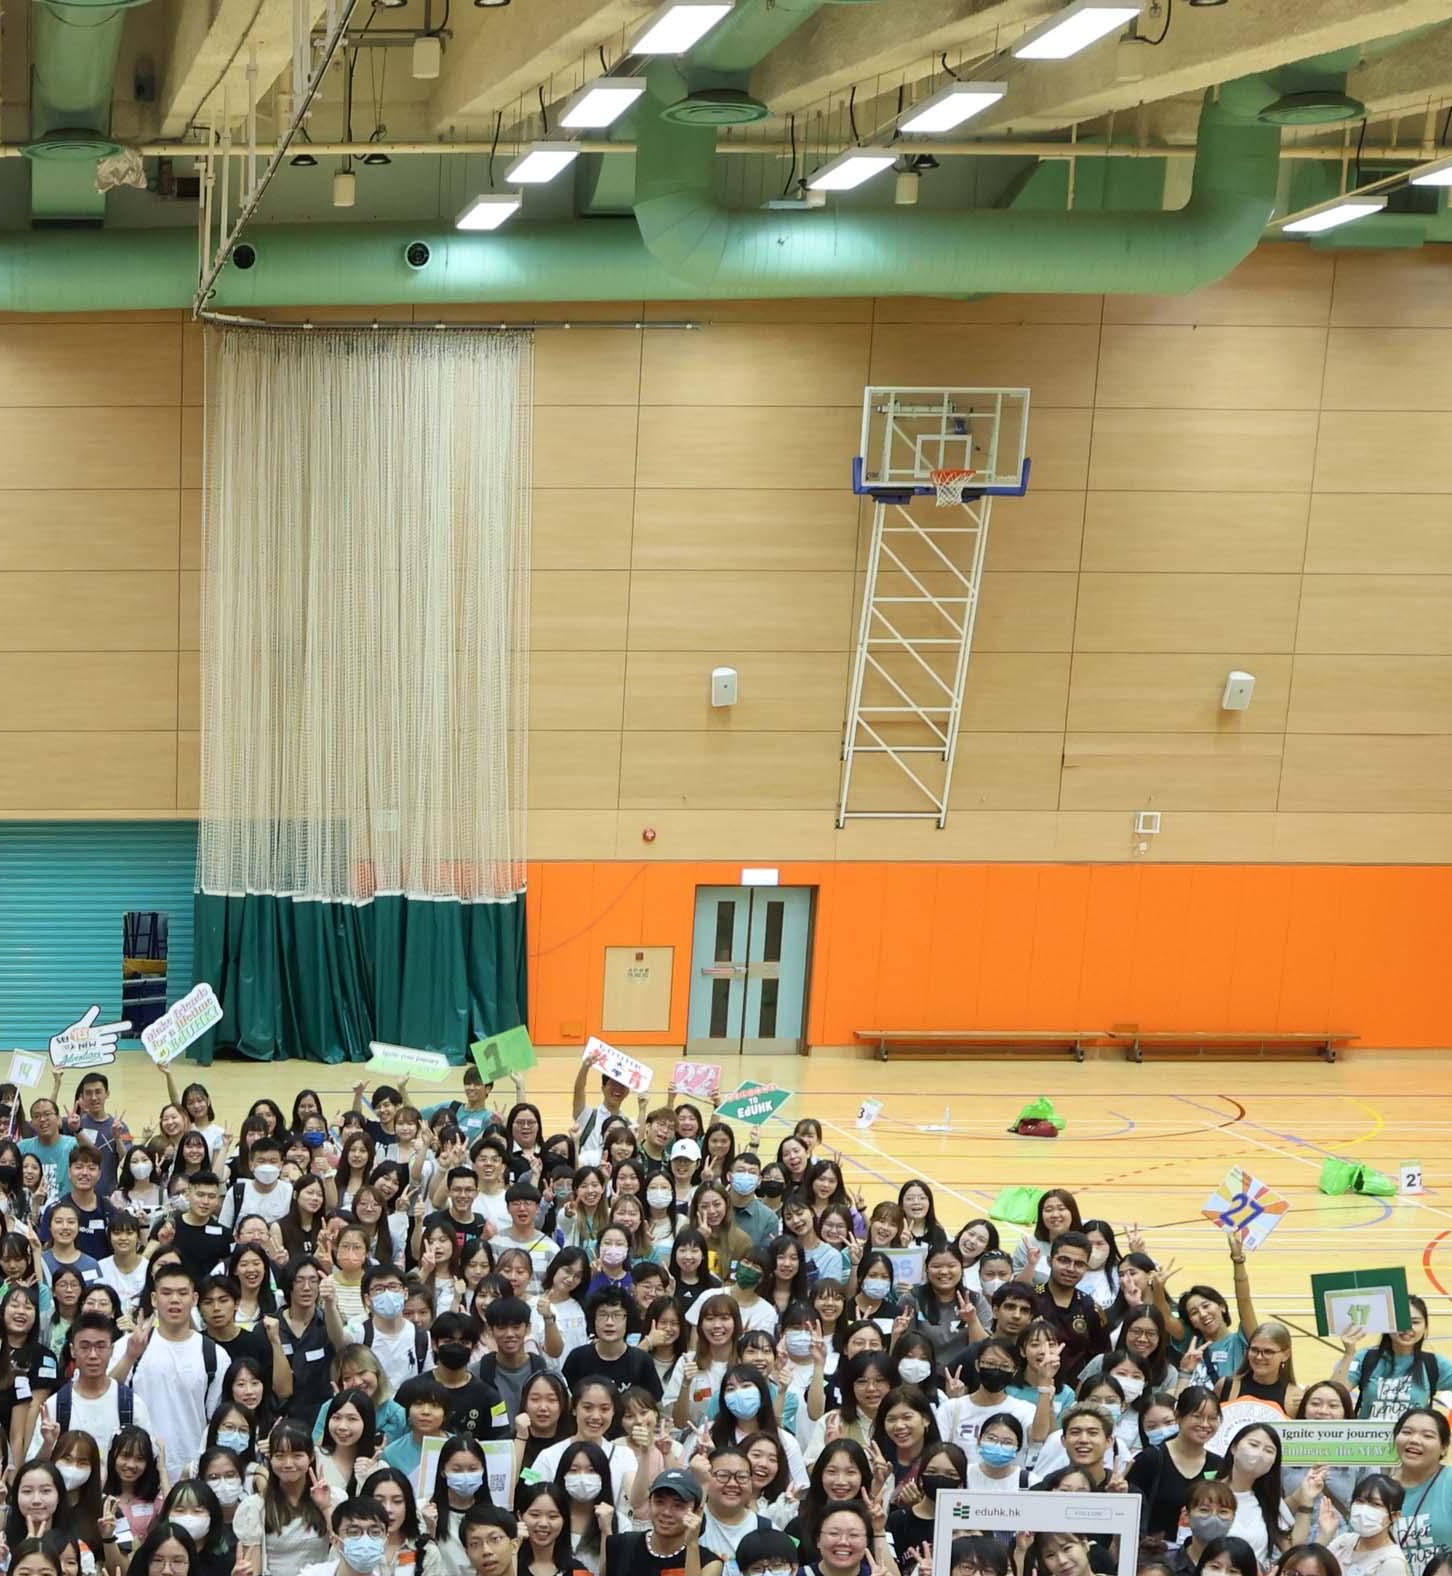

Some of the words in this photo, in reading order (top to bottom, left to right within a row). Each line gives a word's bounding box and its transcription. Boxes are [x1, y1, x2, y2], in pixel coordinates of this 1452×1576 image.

[737, 1102, 773, 1119] EdUHK
[1282, 1428, 1314, 1442] Ignite
[1317, 1430, 1345, 1443] your
[1346, 1428, 1392, 1442] journey
[974, 1506, 1021, 1517] eduhk.hk
